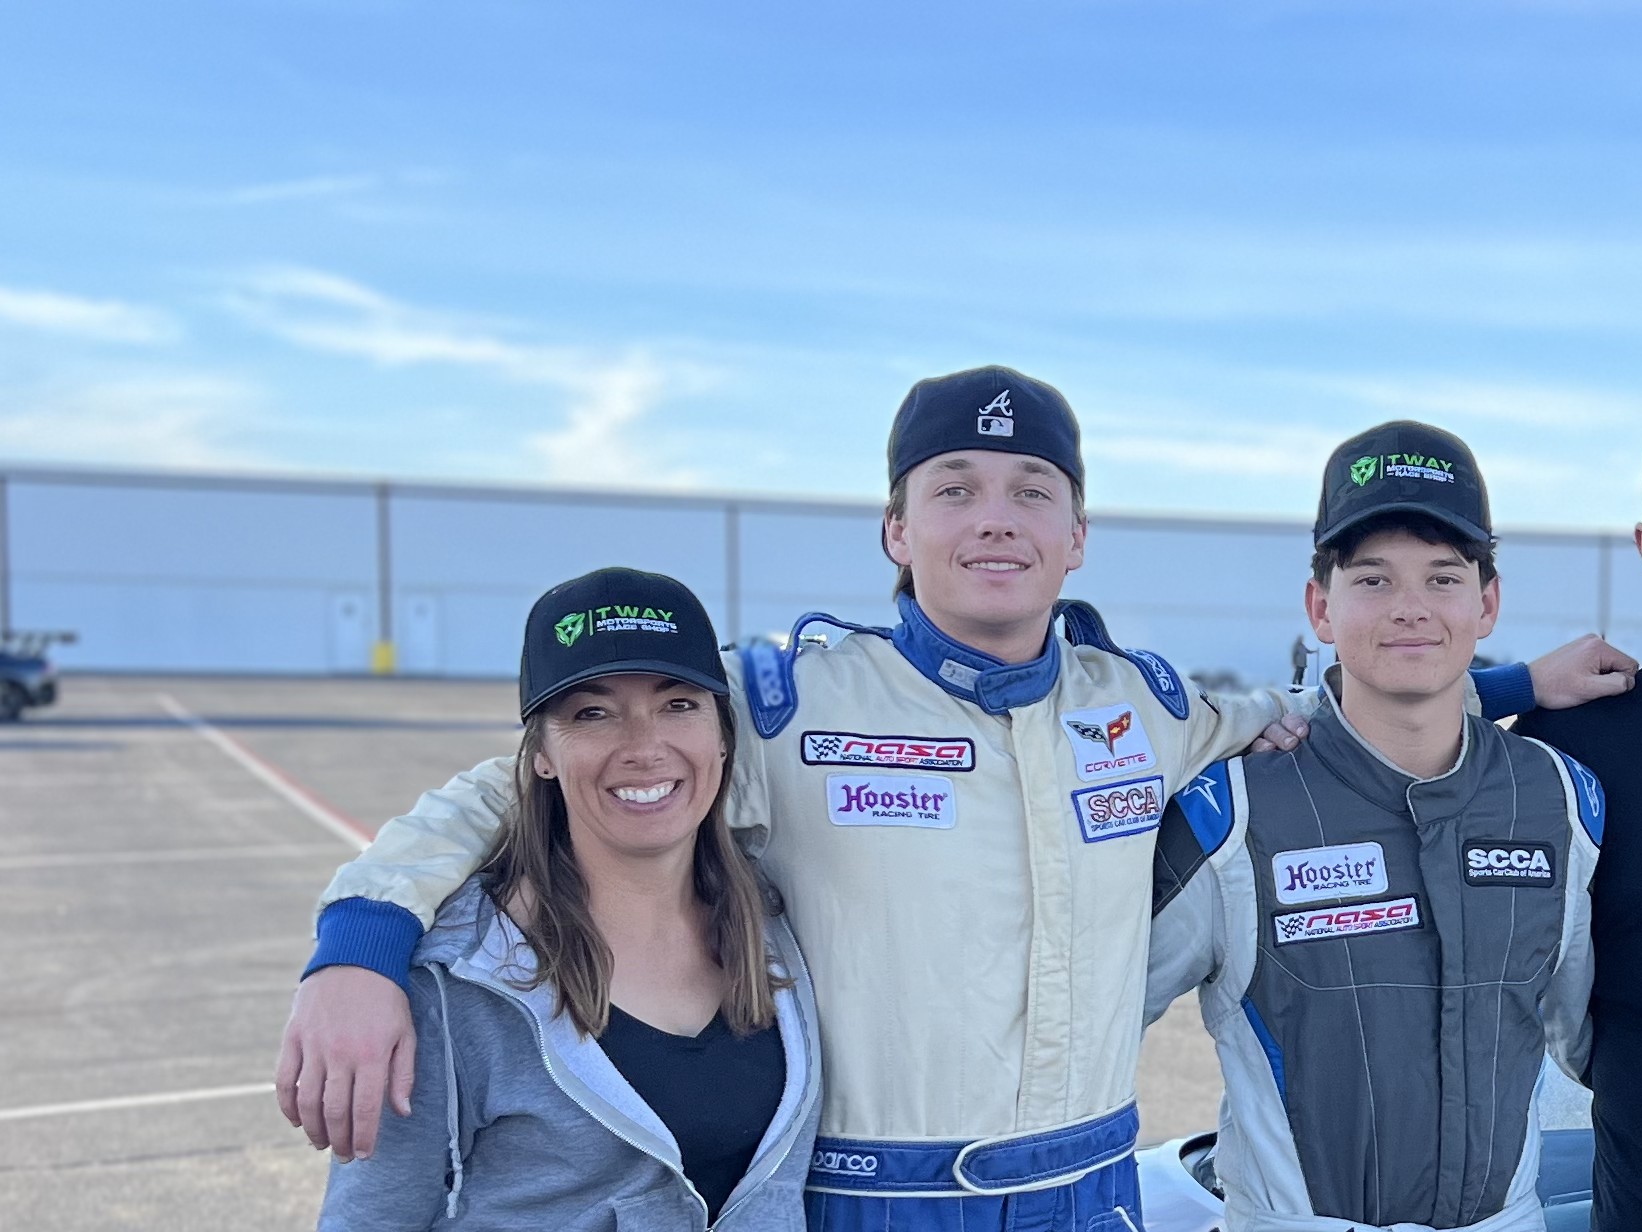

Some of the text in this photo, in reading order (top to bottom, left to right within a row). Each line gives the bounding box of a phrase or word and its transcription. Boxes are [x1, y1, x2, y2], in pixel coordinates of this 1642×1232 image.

[1387, 454, 1453, 471] TWAY
[596, 605, 673, 621] TWAY
[597, 618, 677, 629] MOTORSPORTS
[1085, 753, 1147, 773] CORVETTE
[837, 782, 945, 813] Hoosier
[1088, 786, 1160, 822] SCCA
[872, 810, 940, 820] RACING TIRE
[1467, 848, 1550, 870] SCCA
[1283, 855, 1375, 891] Hoosier
[1313, 880, 1349, 891] RACING
